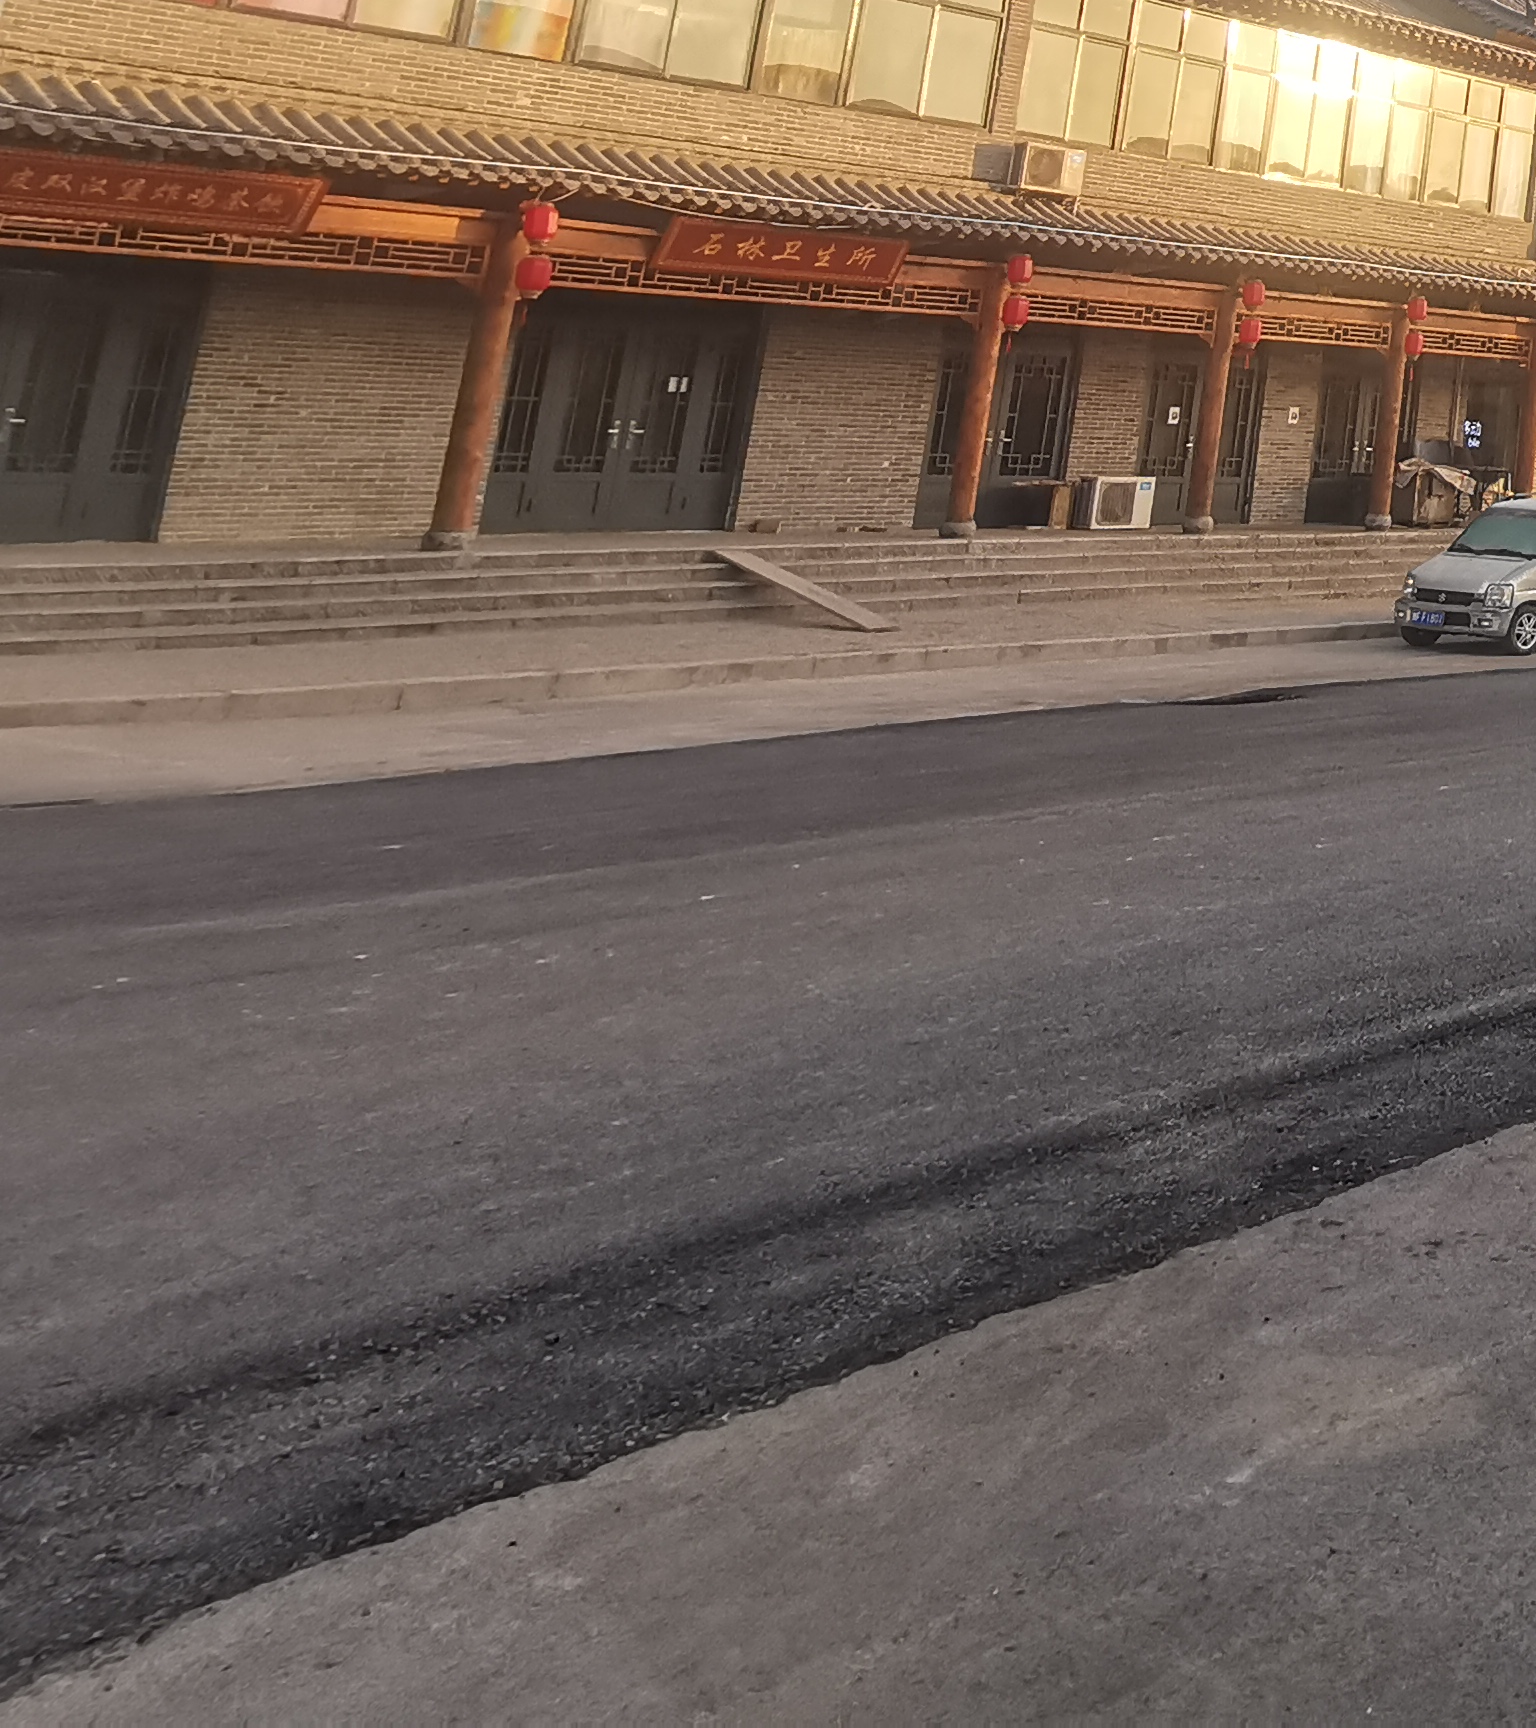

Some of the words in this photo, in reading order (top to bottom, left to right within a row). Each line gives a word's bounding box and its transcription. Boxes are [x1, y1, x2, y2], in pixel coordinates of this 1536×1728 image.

[693, 233, 876, 270] 石林卫生所
